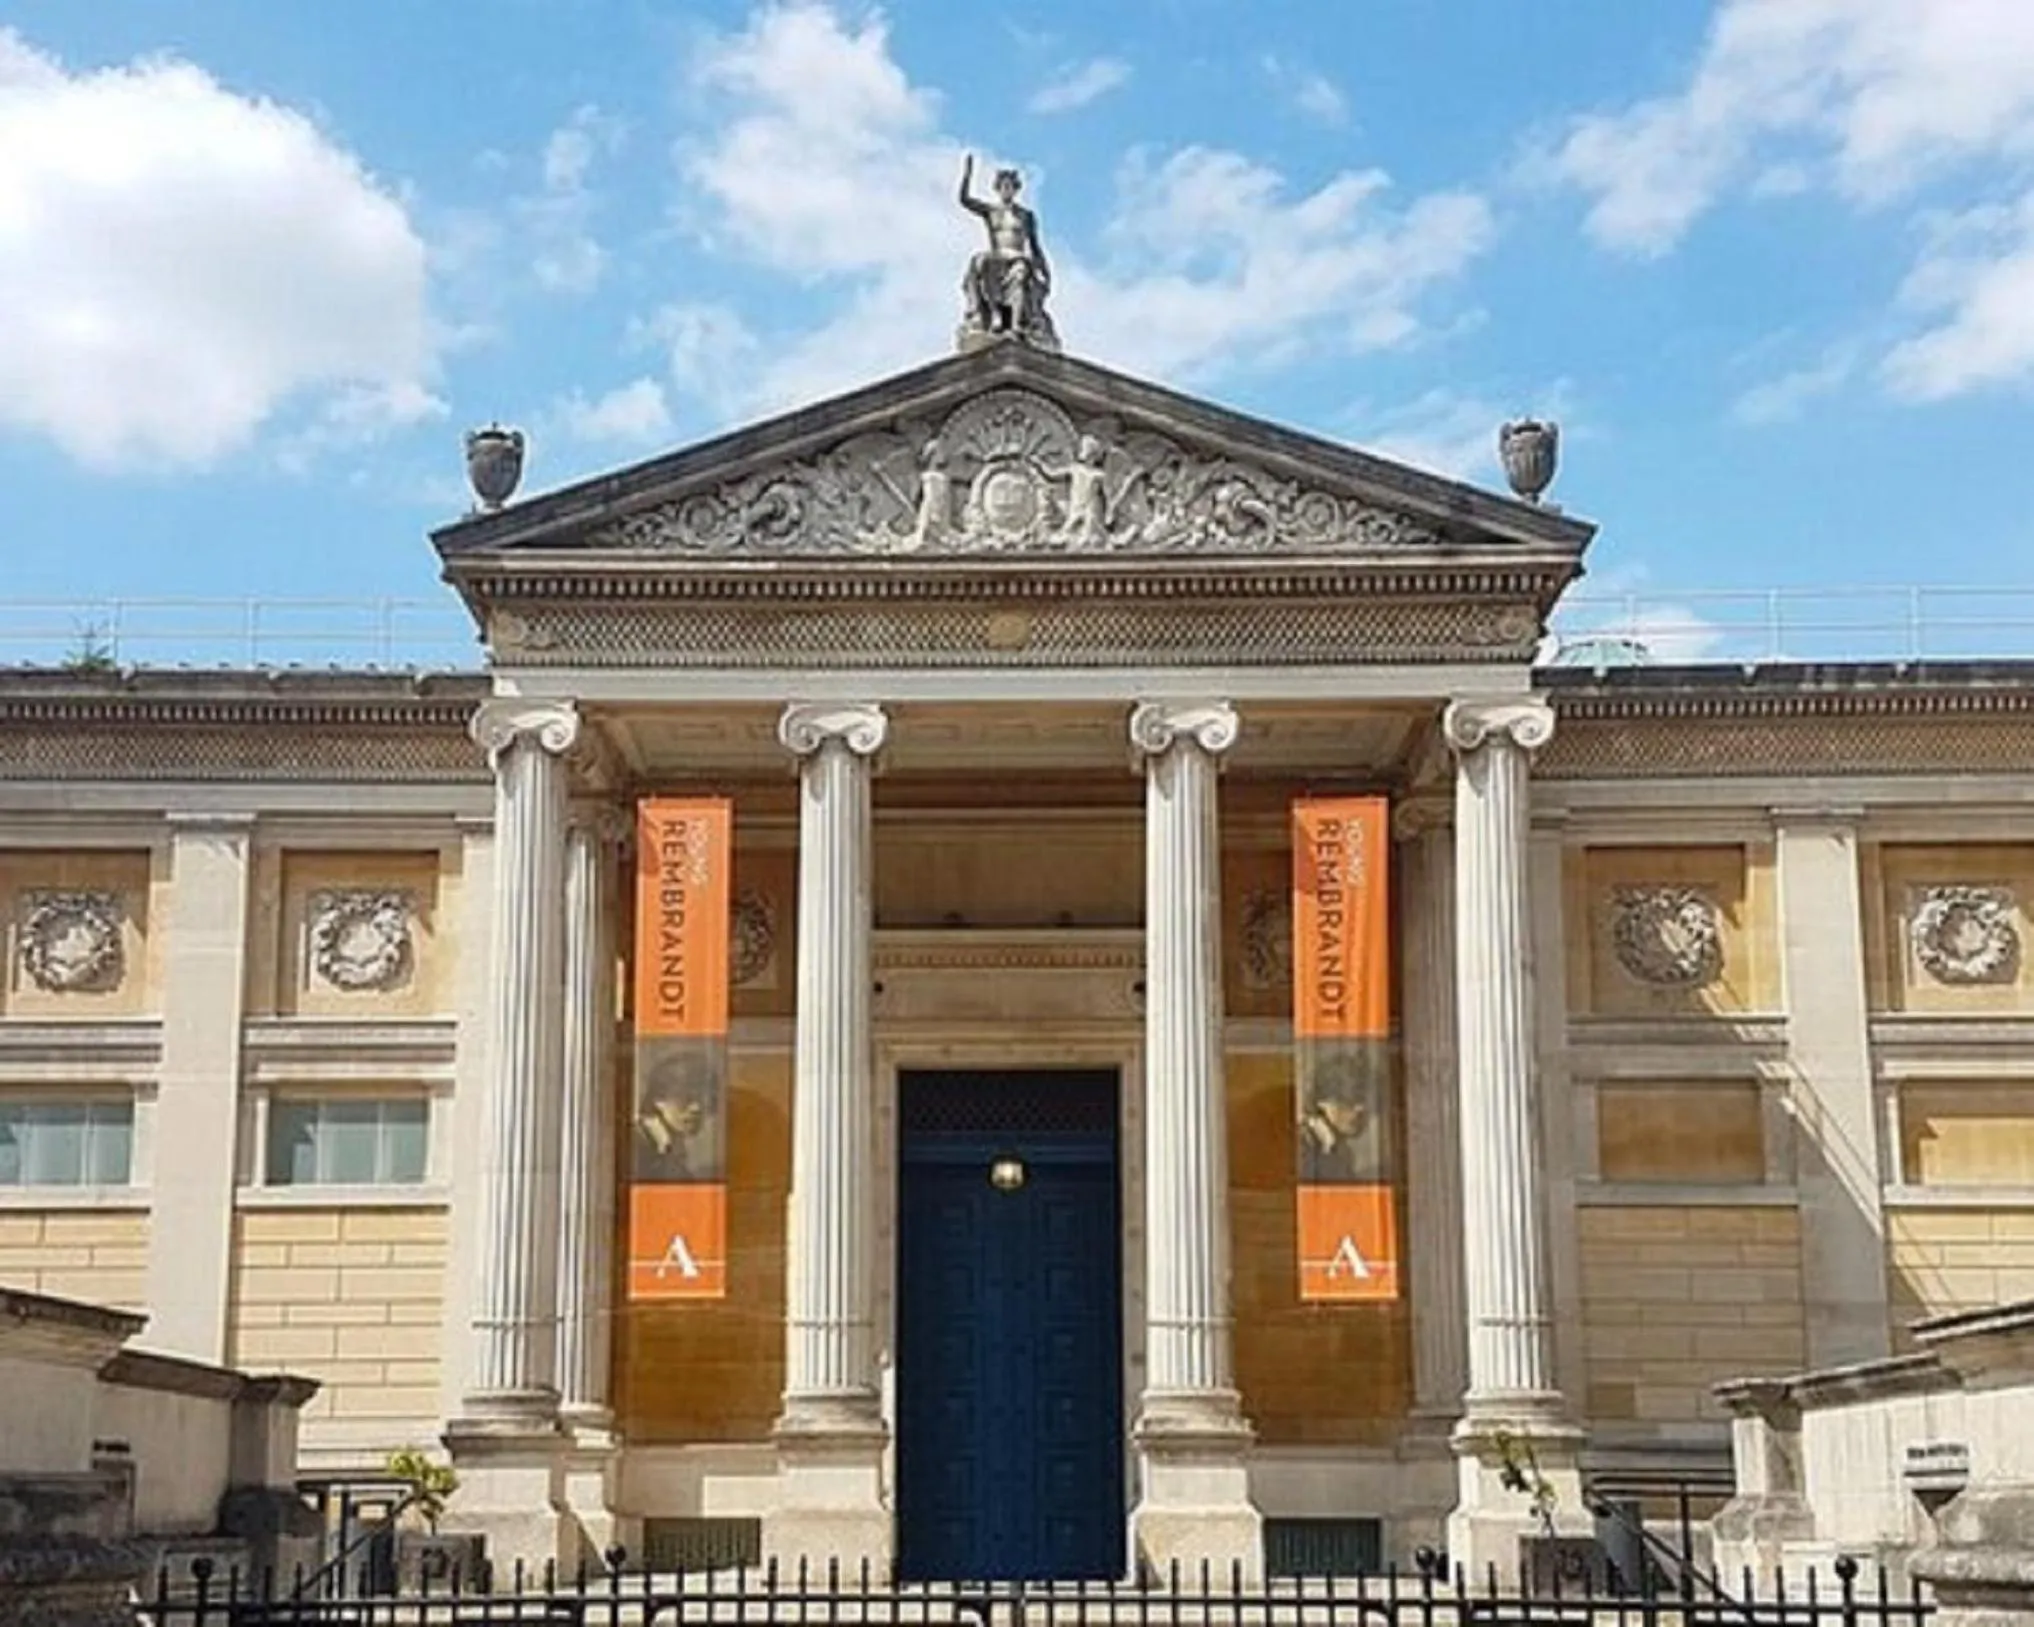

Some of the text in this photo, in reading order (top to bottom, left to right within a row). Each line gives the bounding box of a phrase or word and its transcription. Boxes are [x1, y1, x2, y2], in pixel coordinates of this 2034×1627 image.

[659, 819, 686, 1023] REMBRANDT
[1317, 818, 1346, 1023] REMBRANDT
[656, 1234, 699, 1279] A
[1327, 1234, 1369, 1279] A
